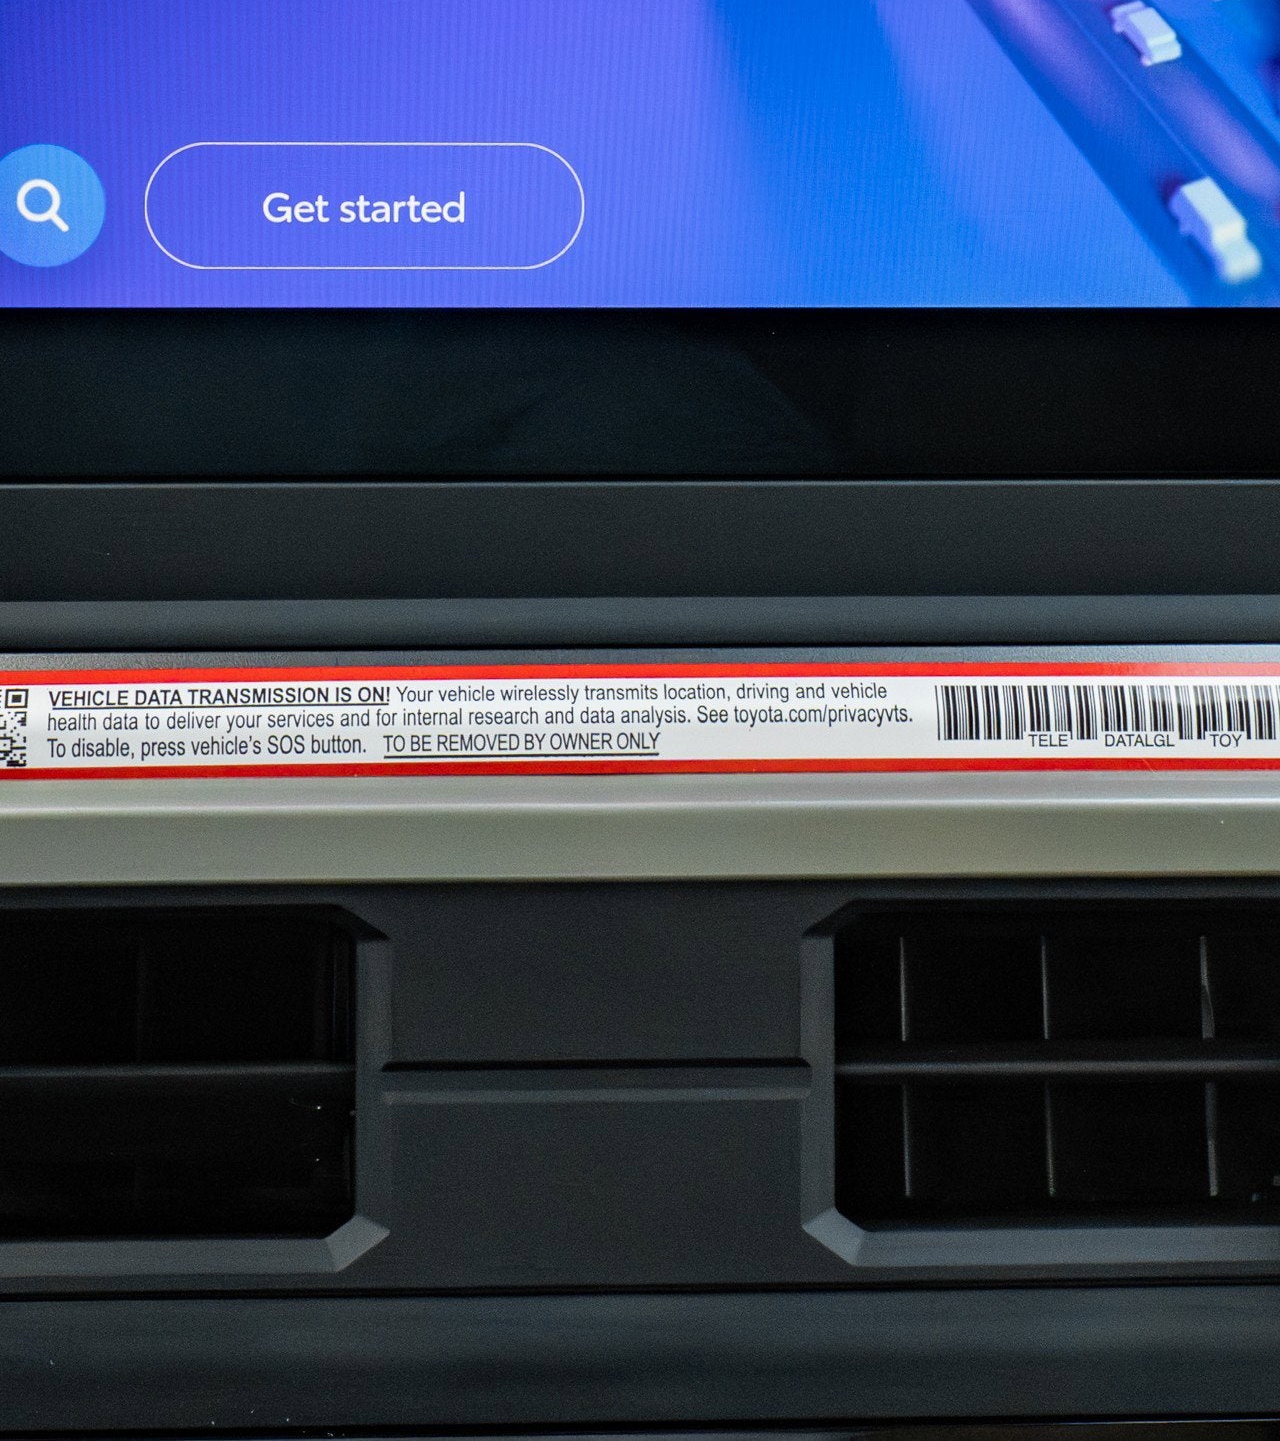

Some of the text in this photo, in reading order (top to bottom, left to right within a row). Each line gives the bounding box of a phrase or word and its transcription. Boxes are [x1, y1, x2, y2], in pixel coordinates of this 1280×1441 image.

[262, 190, 466, 224] Get started
[49, 682, 887, 708] VEHICLE DATA TRANSMISSION IS ON! Your vehicle wirelessly transmits location, driving and vehicle
[47, 704, 914, 733] health data to deliver your services and for internal research and data analysis. See toyota.com/privacyvts.
[47, 738, 66, 758] To
[71, 736, 135, 759] disable,
[141, 738, 186, 761] press
[267, 735, 305, 755] SOS
[311, 734, 367, 754] button.
[383, 734, 406, 753] TO
[410, 734, 432, 752] BE
[436, 733, 520, 752] REMOVED
[524, 732, 545, 751] BY
[549, 732, 613, 751] OWNER
[617, 731, 661, 750] ONLY
[1028, 732, 1242, 748] TELE DATALGL TOY
